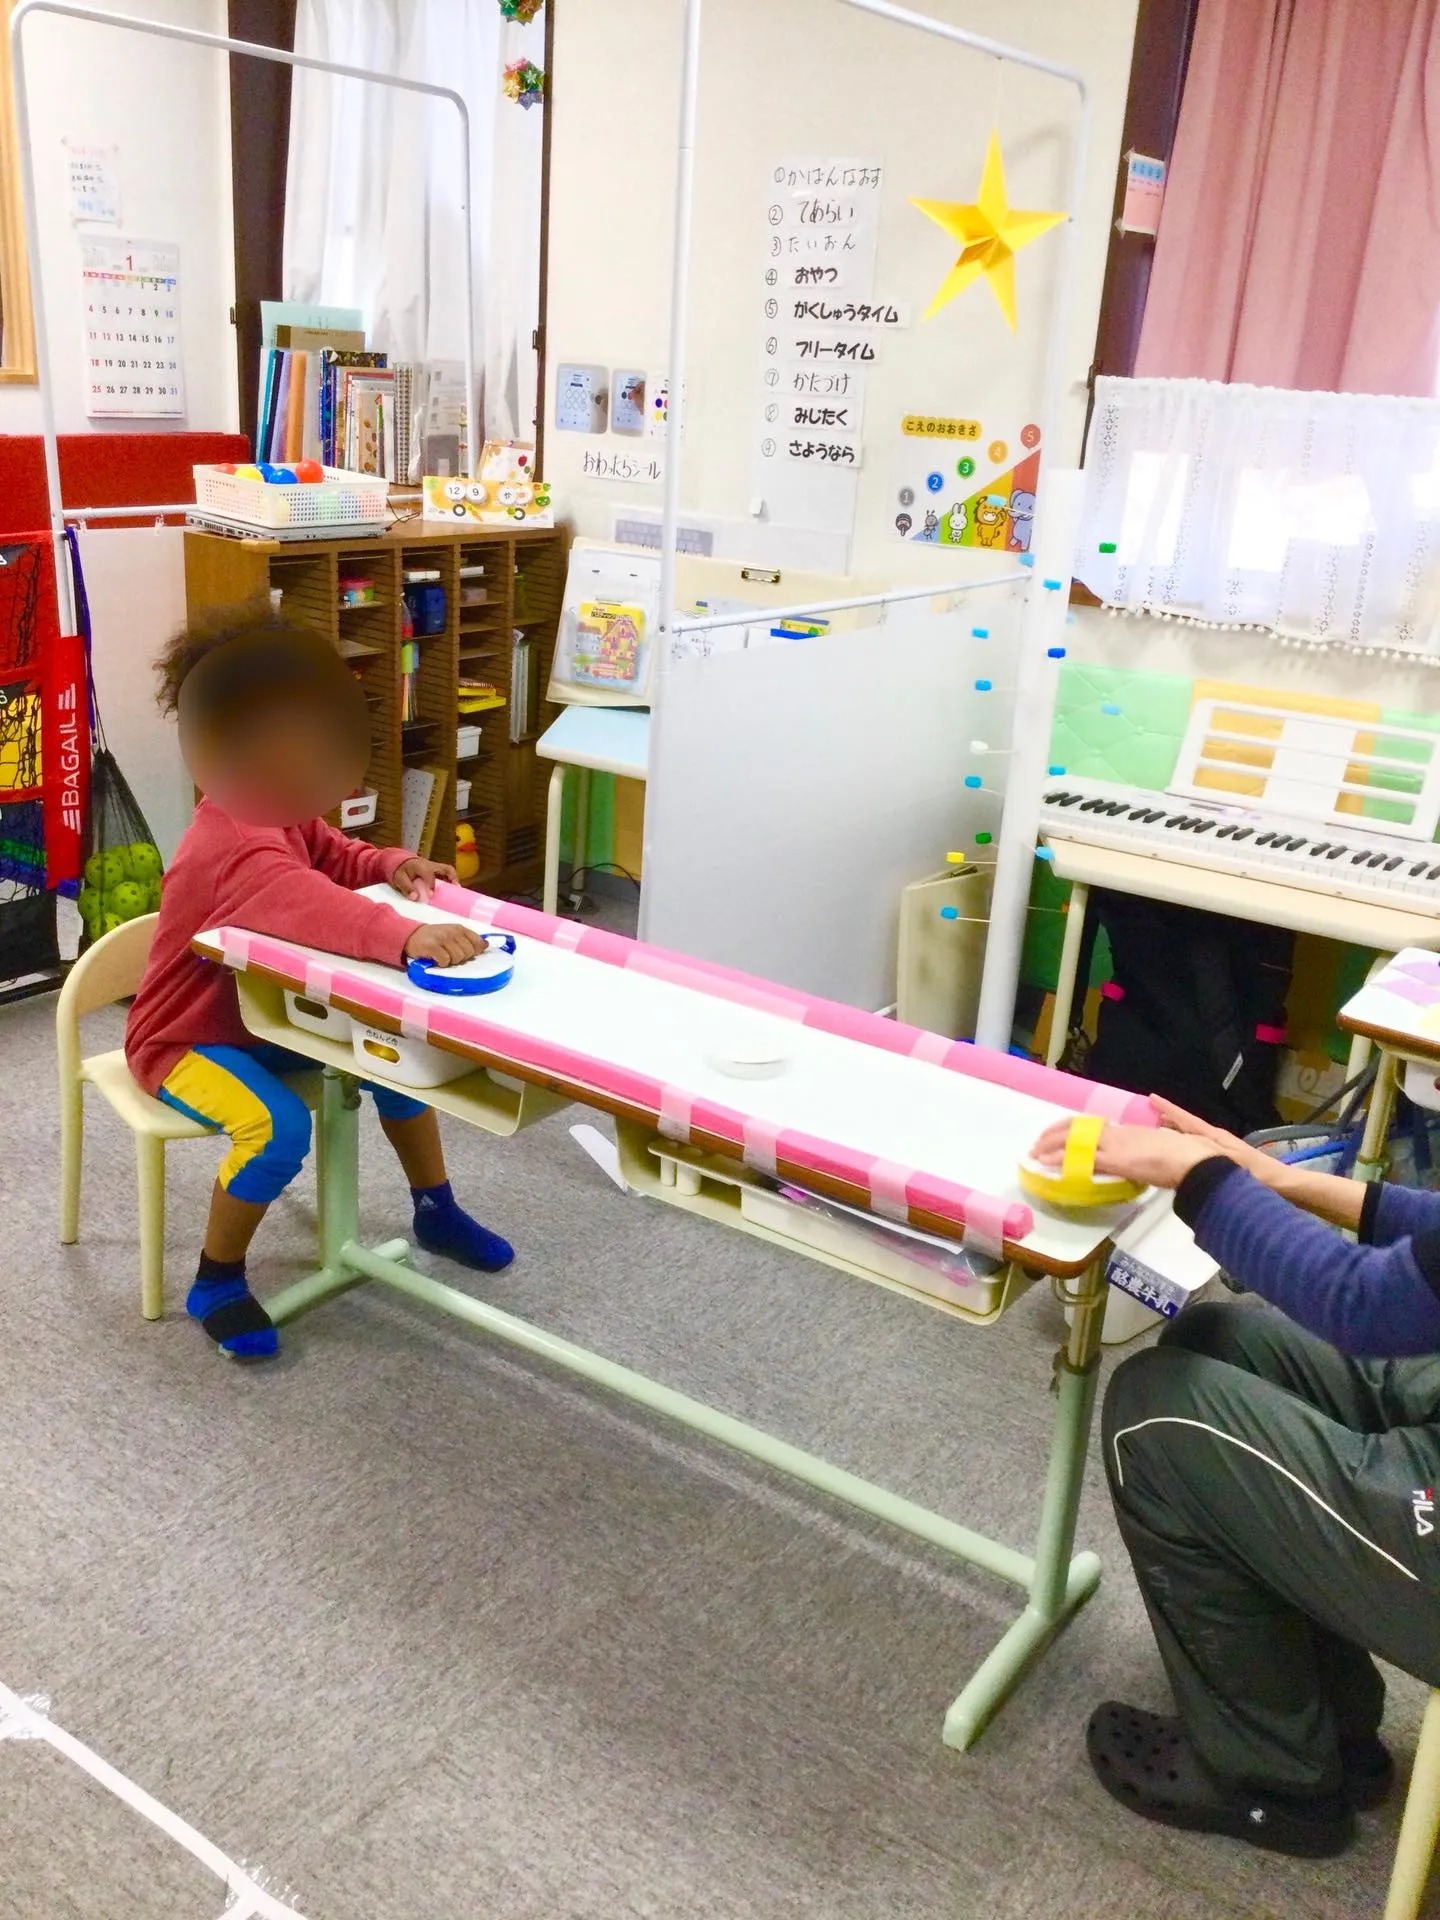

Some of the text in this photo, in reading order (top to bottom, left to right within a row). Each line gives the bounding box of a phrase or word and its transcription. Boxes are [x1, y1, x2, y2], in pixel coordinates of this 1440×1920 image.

[798, 199, 854, 223] てあらい
[788, 234, 855, 253] たいおん
[126, 255, 133, 271] 1
[795, 266, 838, 284] おやつ
[102, 305, 107, 313] 5
[115, 306, 120, 315] 6
[128, 308, 133, 316] 7
[141, 309, 146, 317] 8
[154, 310, 159, 318] 9
[165, 310, 173, 318] 10
[794, 301, 898, 322] がくしゅうタイム
[89, 332, 174, 344] 11 12 13 14 15 16 17
[796, 341, 875, 360] フリータイム
[91, 359, 177, 370] 18 19 20 21 22 23 24
[93, 385, 178, 395] 25 26 27 28 29 30 31
[793, 372, 851, 394] かたづけ
[795, 407, 848, 426] みじたく
[906, 420, 977, 437] こえのおおきさ
[789, 440, 855, 463] さようなら
[448, 487, 479, 496] 12 9
[59, 708, 80, 808] BAGAIL
[1110, 1266, 1171, 1315] 酪農牛乳
[1412, 1487, 1434, 1536] FILA
